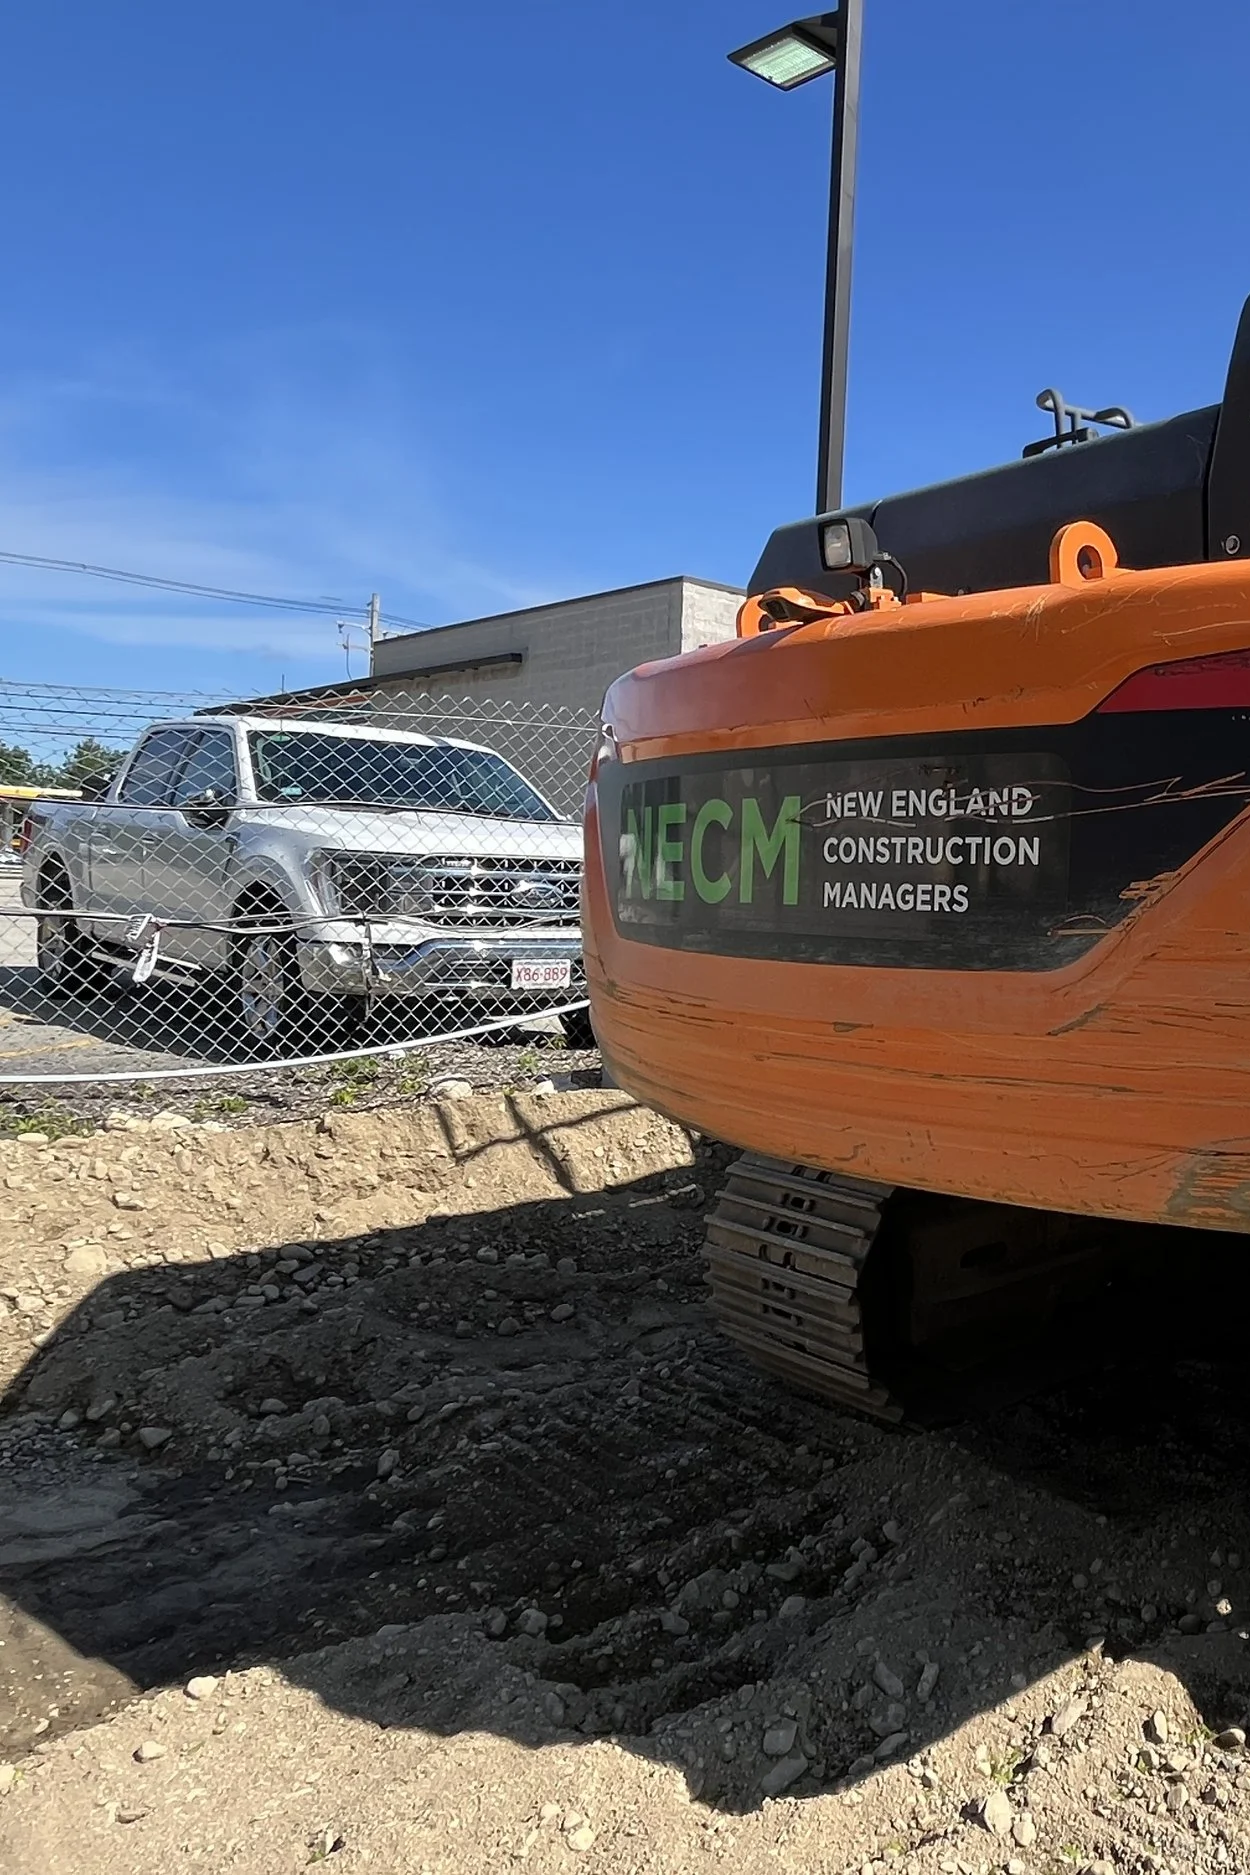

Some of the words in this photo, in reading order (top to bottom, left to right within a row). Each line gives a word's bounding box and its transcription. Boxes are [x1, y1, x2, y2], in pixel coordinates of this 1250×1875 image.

[826, 791, 884, 819] NEW
[891, 787, 1034, 817] ENGLAND
[625, 796, 801, 905] NECM
[823, 837, 1040, 865] CONSTRUCTION
[823, 881, 969, 913] MANAGERS
